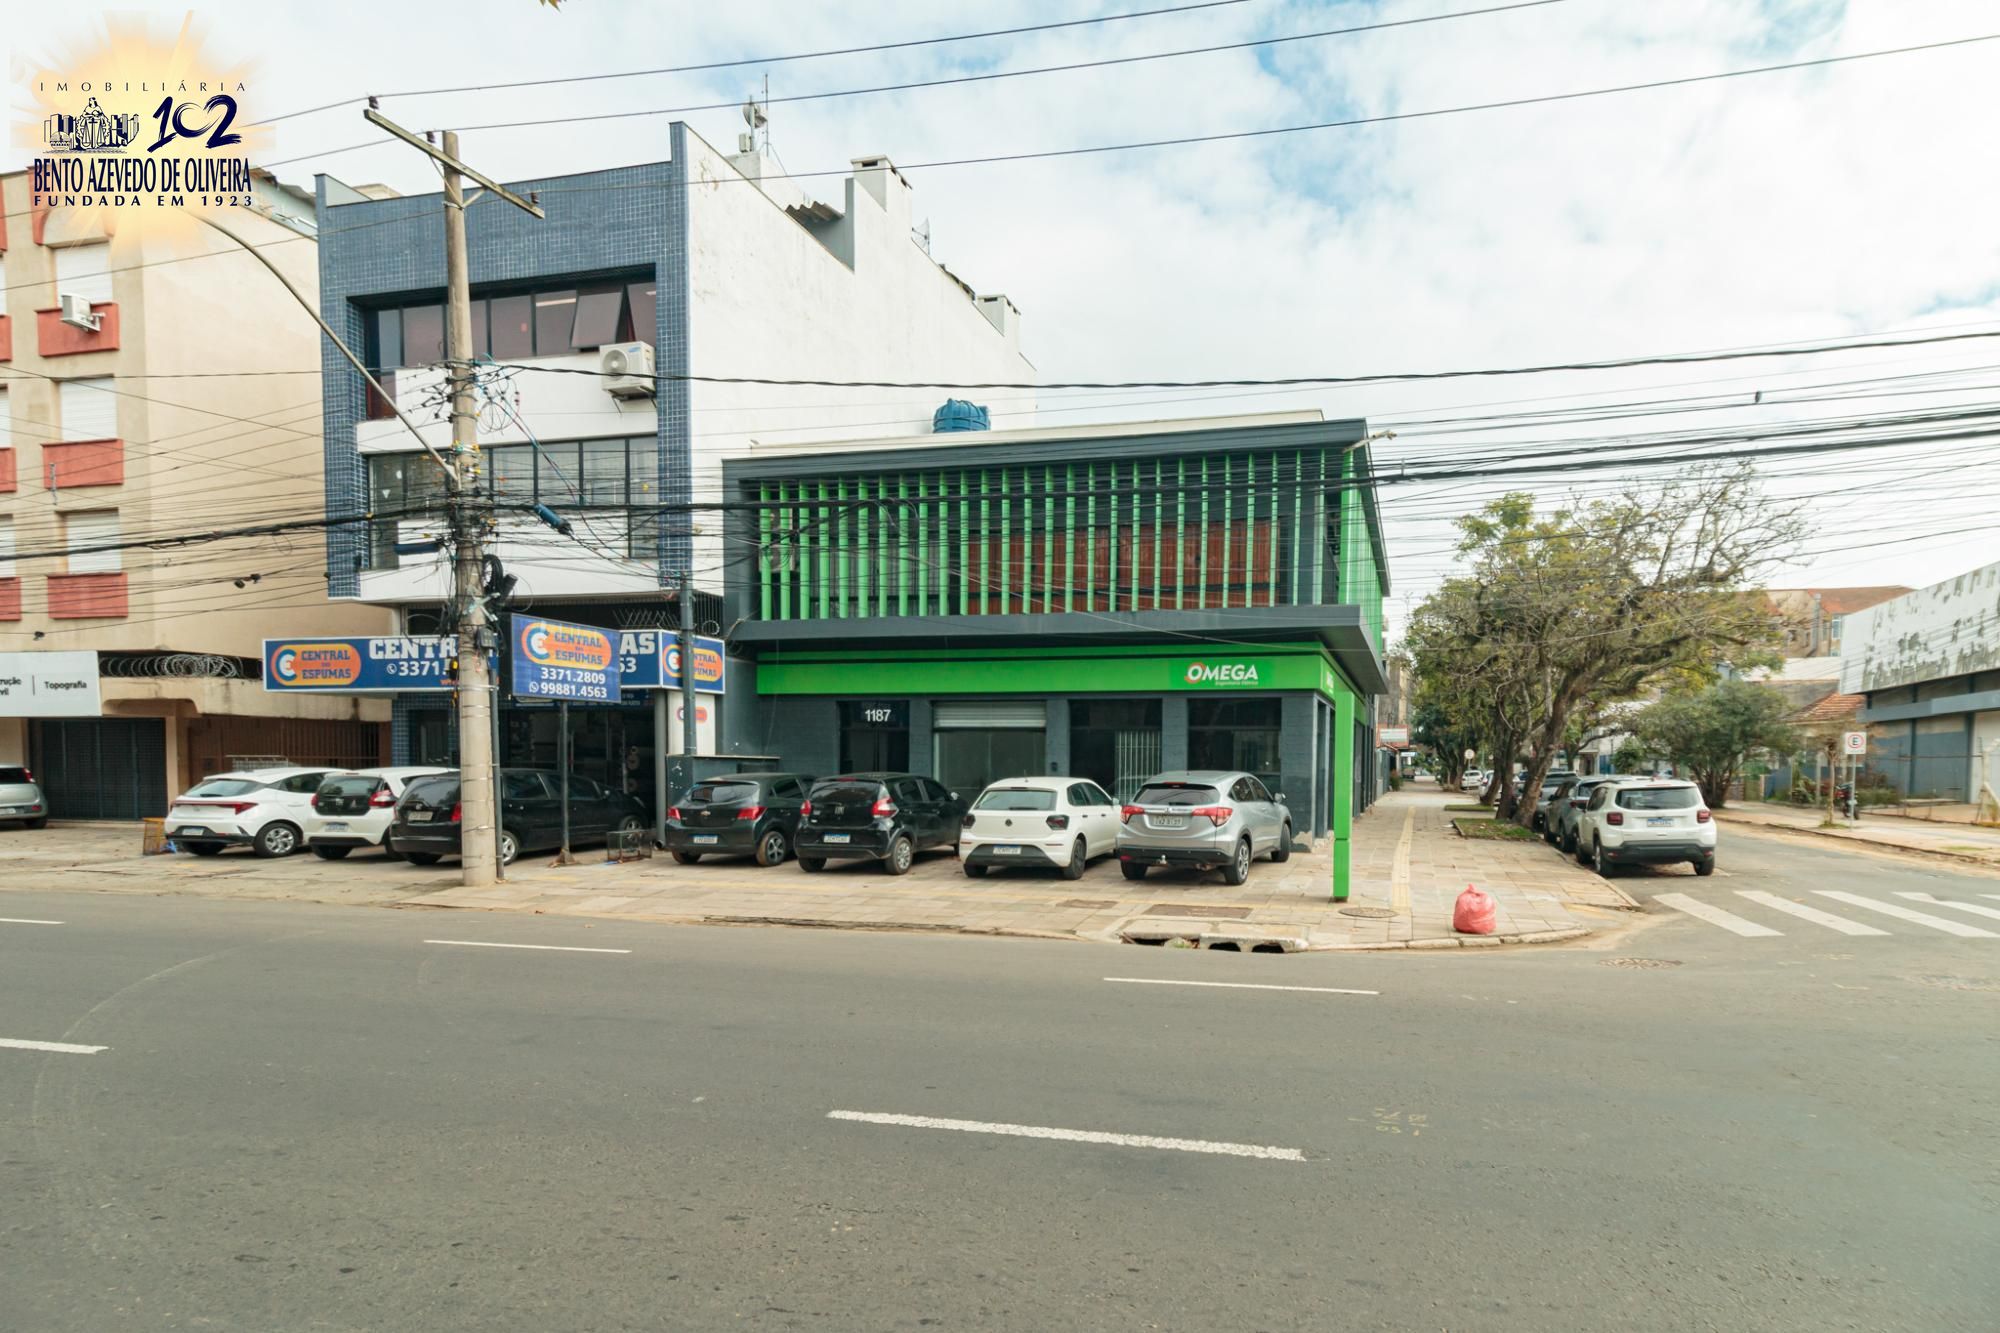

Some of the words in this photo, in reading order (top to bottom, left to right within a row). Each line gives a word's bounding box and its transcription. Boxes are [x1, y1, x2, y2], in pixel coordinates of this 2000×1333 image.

[555, 631, 603, 648] CENTRAL
[301, 650, 351, 660] CENTRAL
[369, 638, 457, 659] CENTR
[555, 650, 603, 665] ESPUMAS
[302, 668, 352, 680] ESPUMAS
[540, 668, 606, 684] 3371.2809
[1186, 662, 1259, 681] OMEGA
[44, 680, 87, 690] Topografia
[540, 682, 607, 698] 99881.4563
[864, 709, 892, 722] 1187
